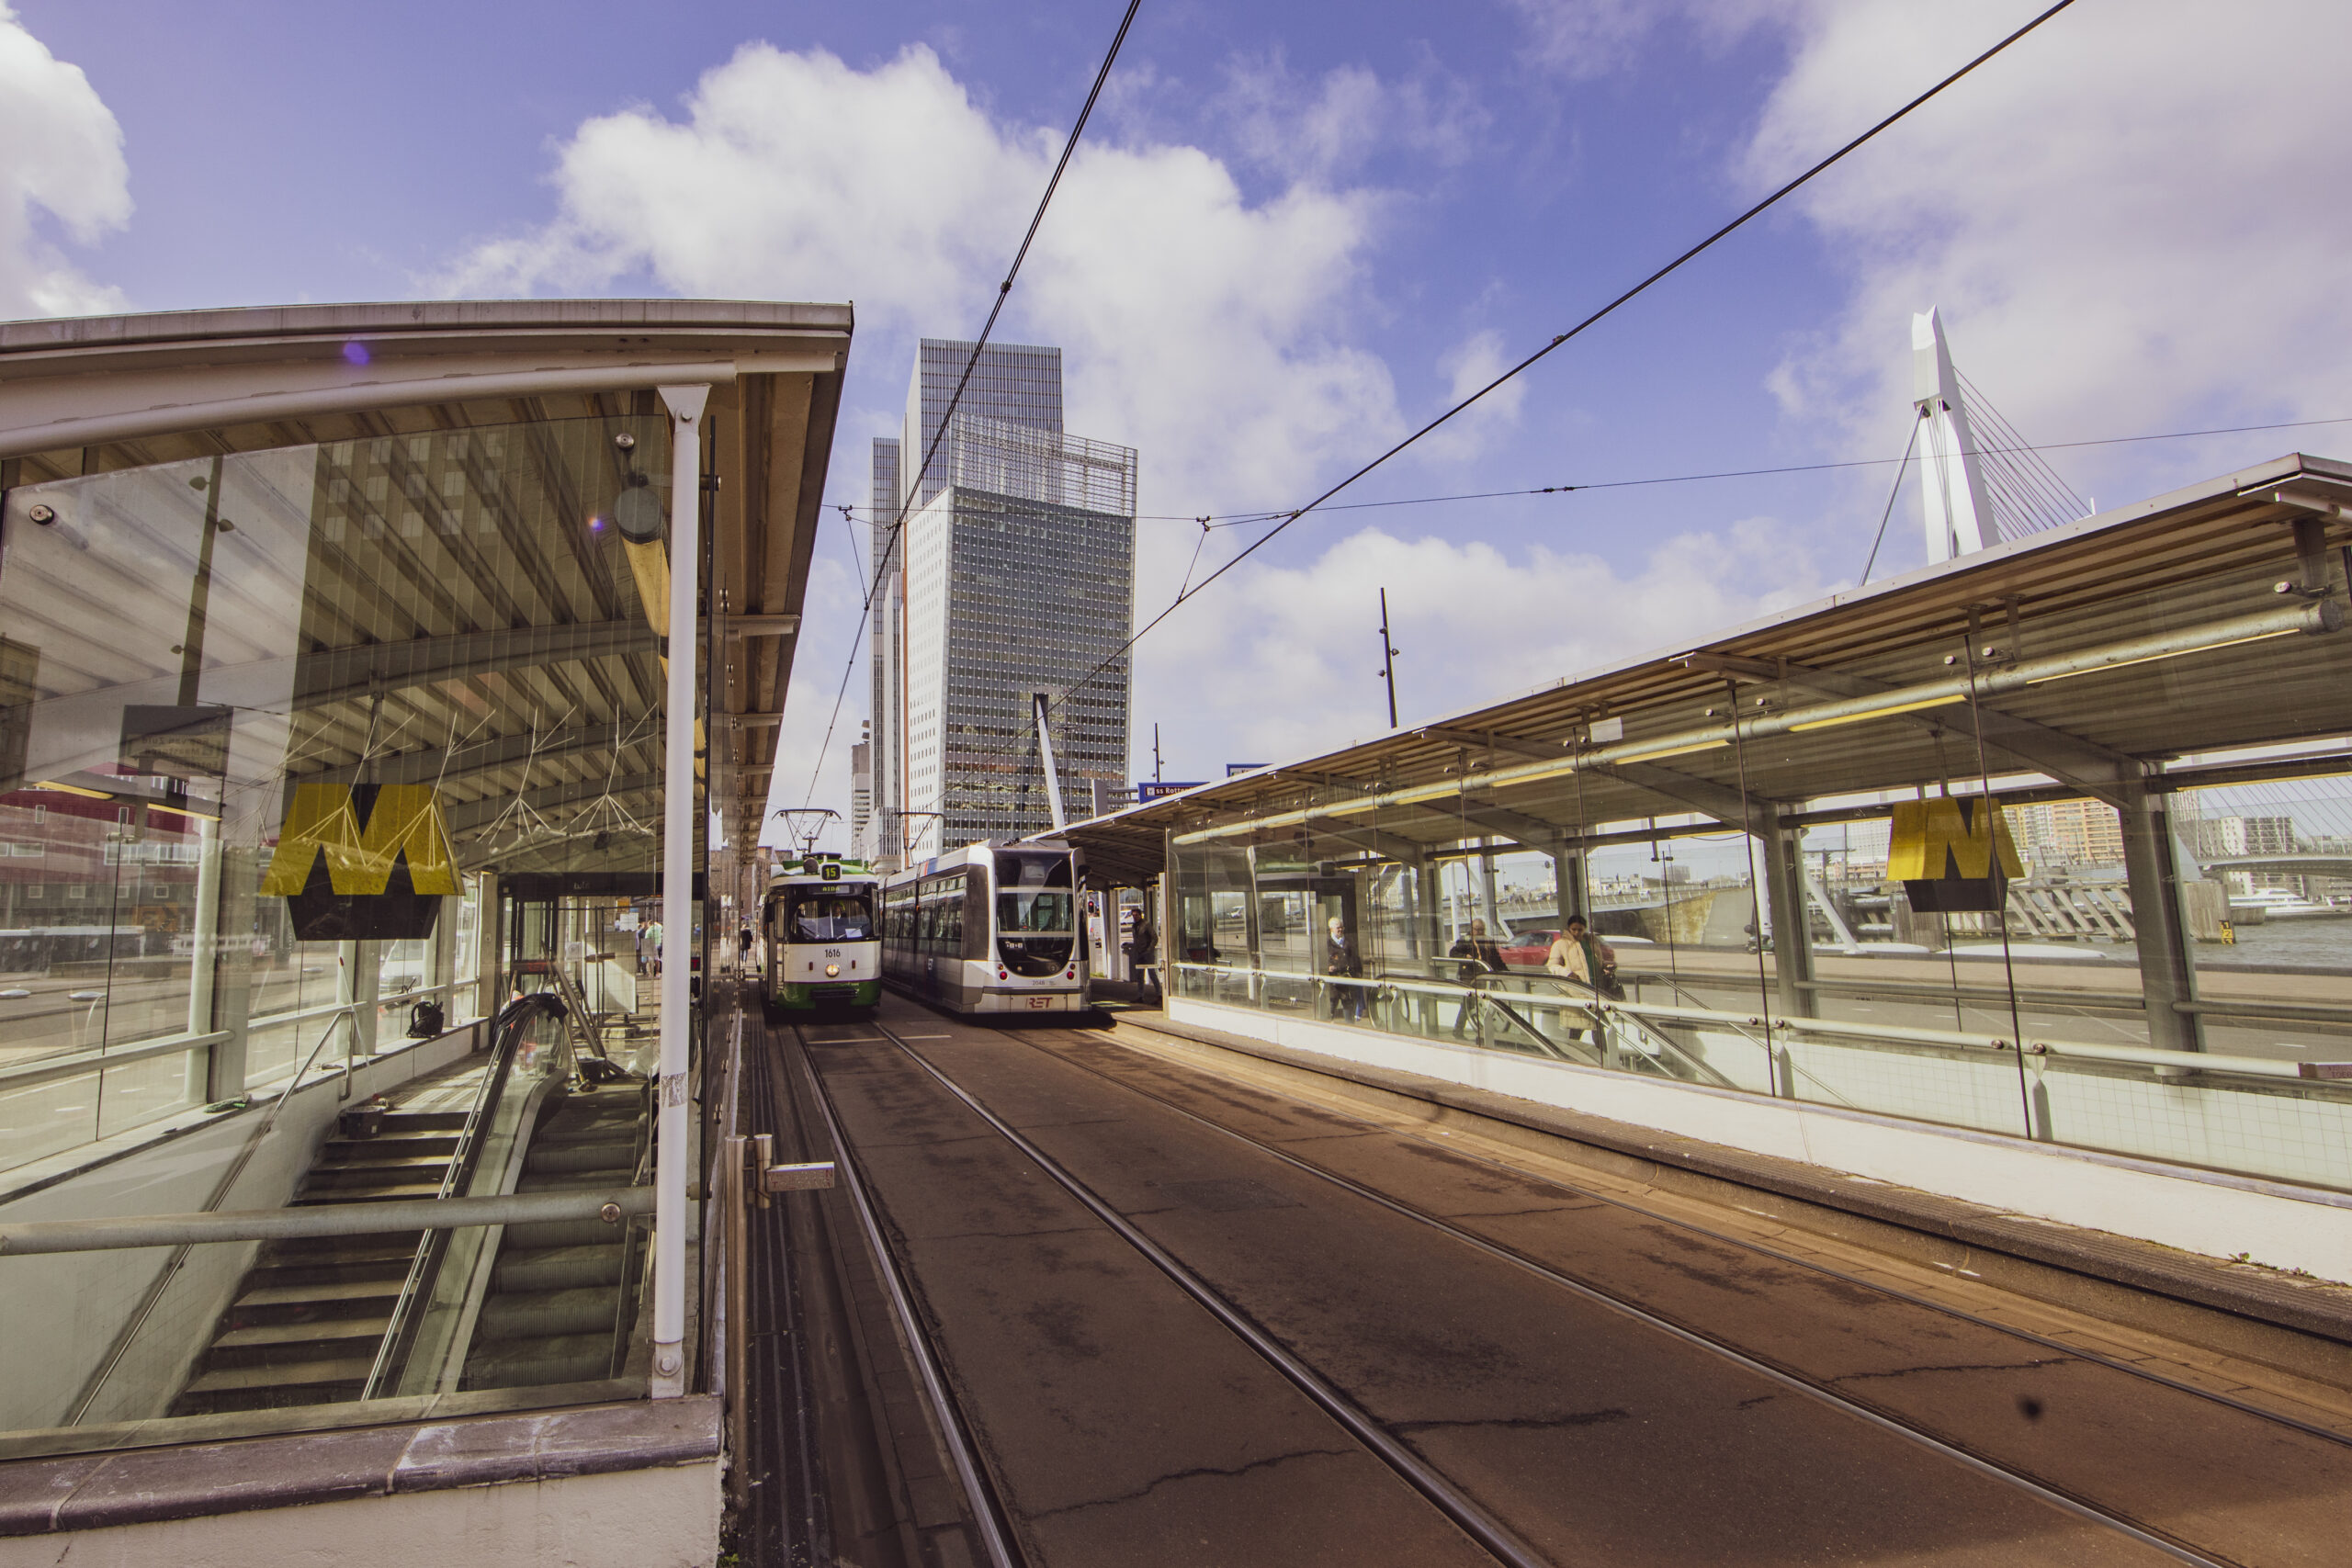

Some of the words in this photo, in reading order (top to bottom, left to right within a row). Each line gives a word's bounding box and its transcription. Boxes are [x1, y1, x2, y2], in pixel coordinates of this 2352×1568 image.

[259, 784, 467, 897] M
[824, 867, 836, 877] 15
[824, 949, 841, 958] 1616
[1029, 997, 1053, 1009] RET
